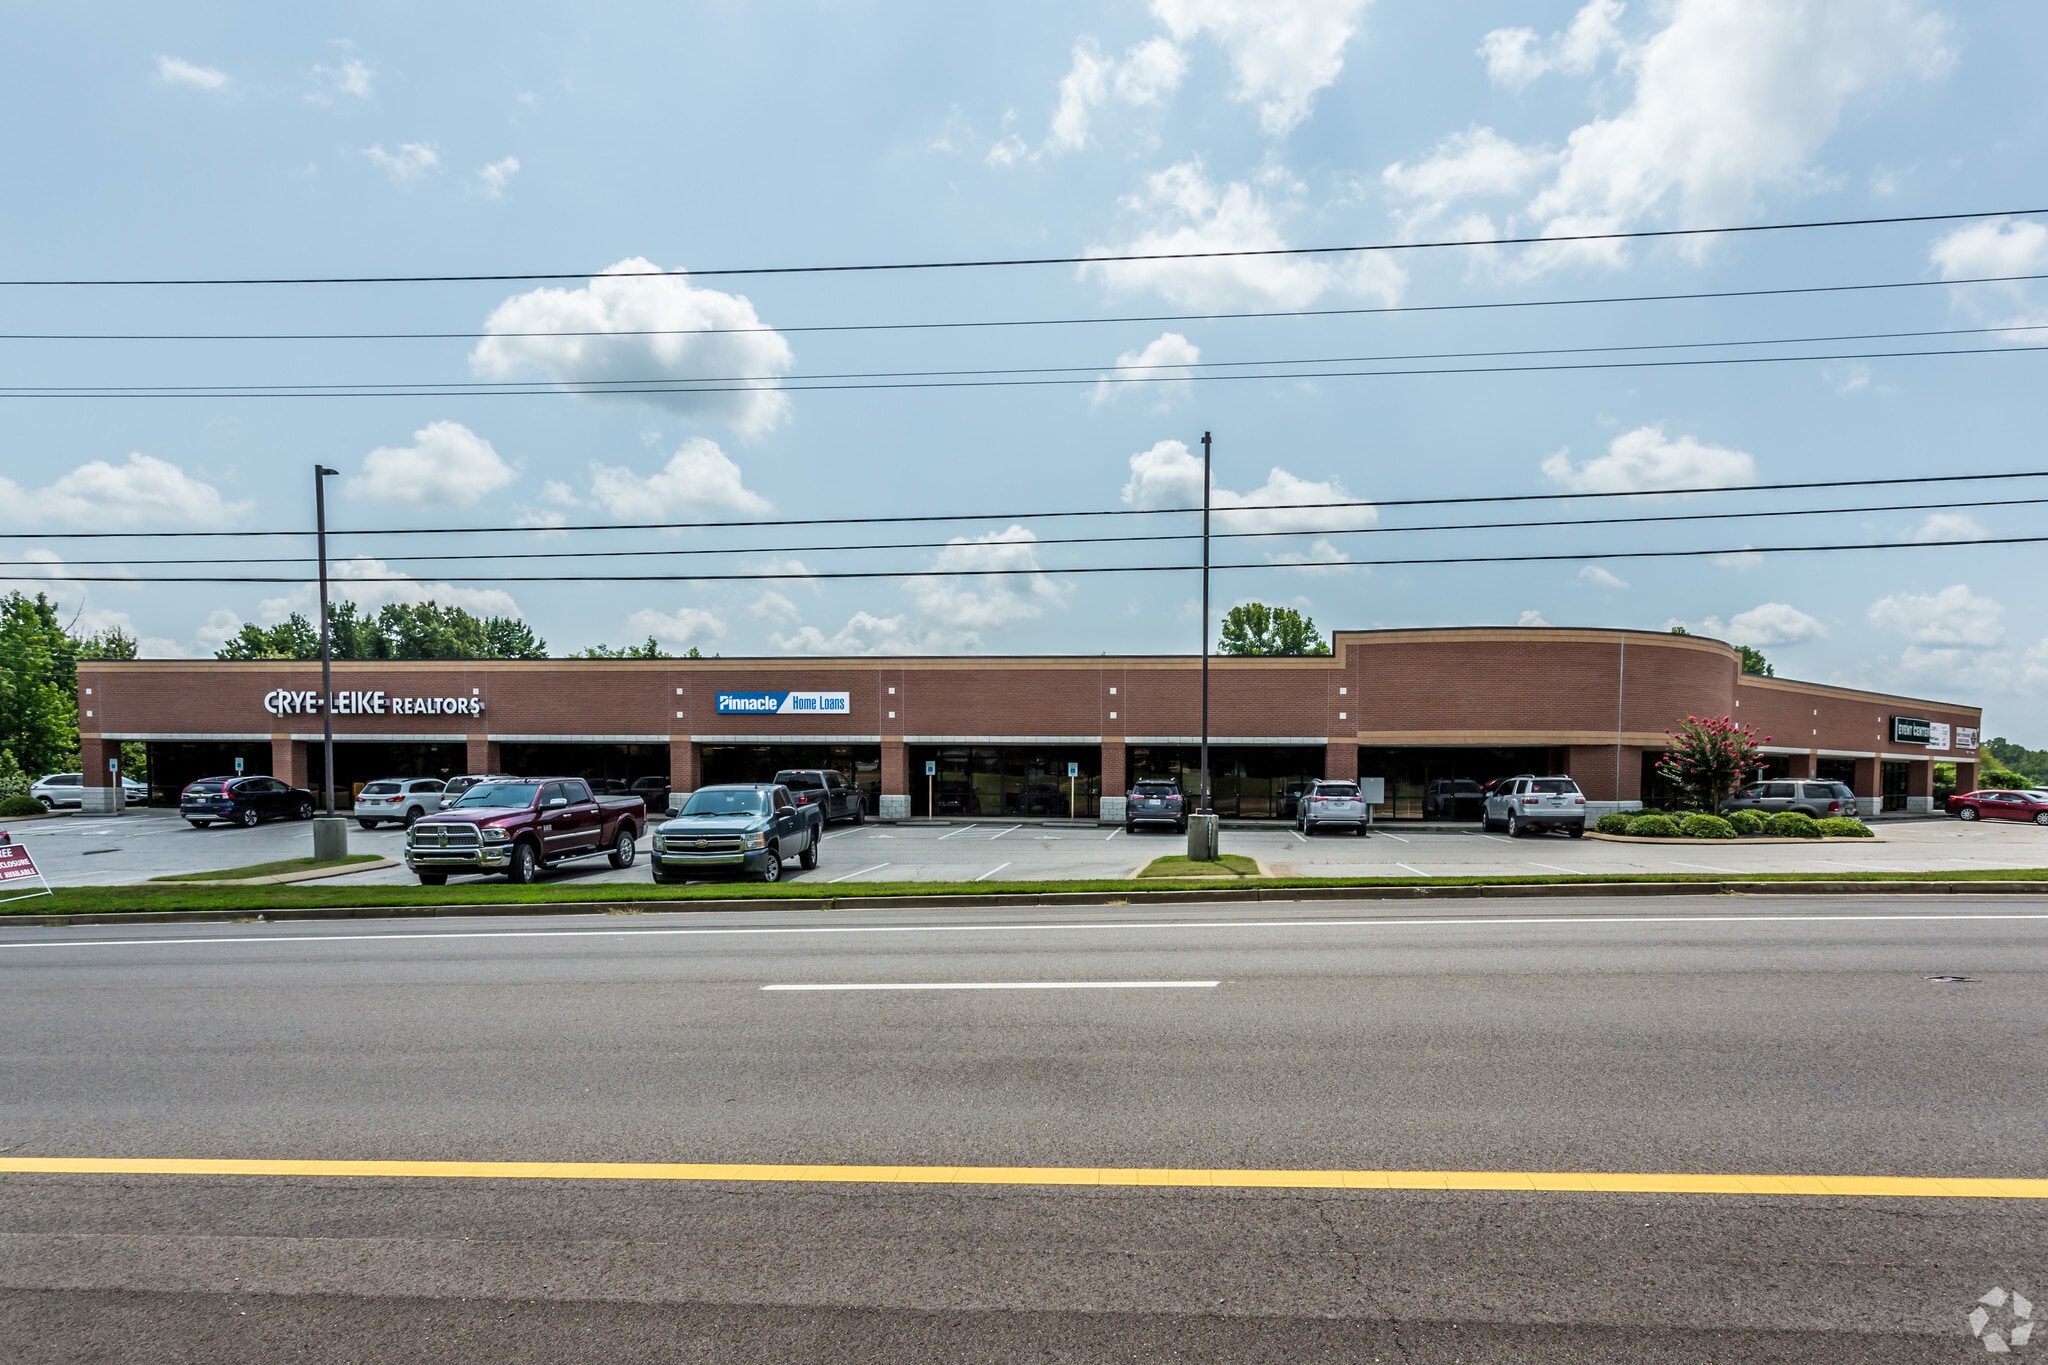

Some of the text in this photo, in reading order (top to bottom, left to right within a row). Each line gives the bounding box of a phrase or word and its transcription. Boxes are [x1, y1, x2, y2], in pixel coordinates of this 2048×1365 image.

[393, 697, 481, 714] REALTORS
[719, 695, 777, 710] Pinnacle
[793, 696, 845, 710] Home Loans
[1898, 724, 1930, 737] EVENT CENTER
[0, 858, 31, 869] CLOSURE
[4, 868, 36, 878] AVAILABLE
